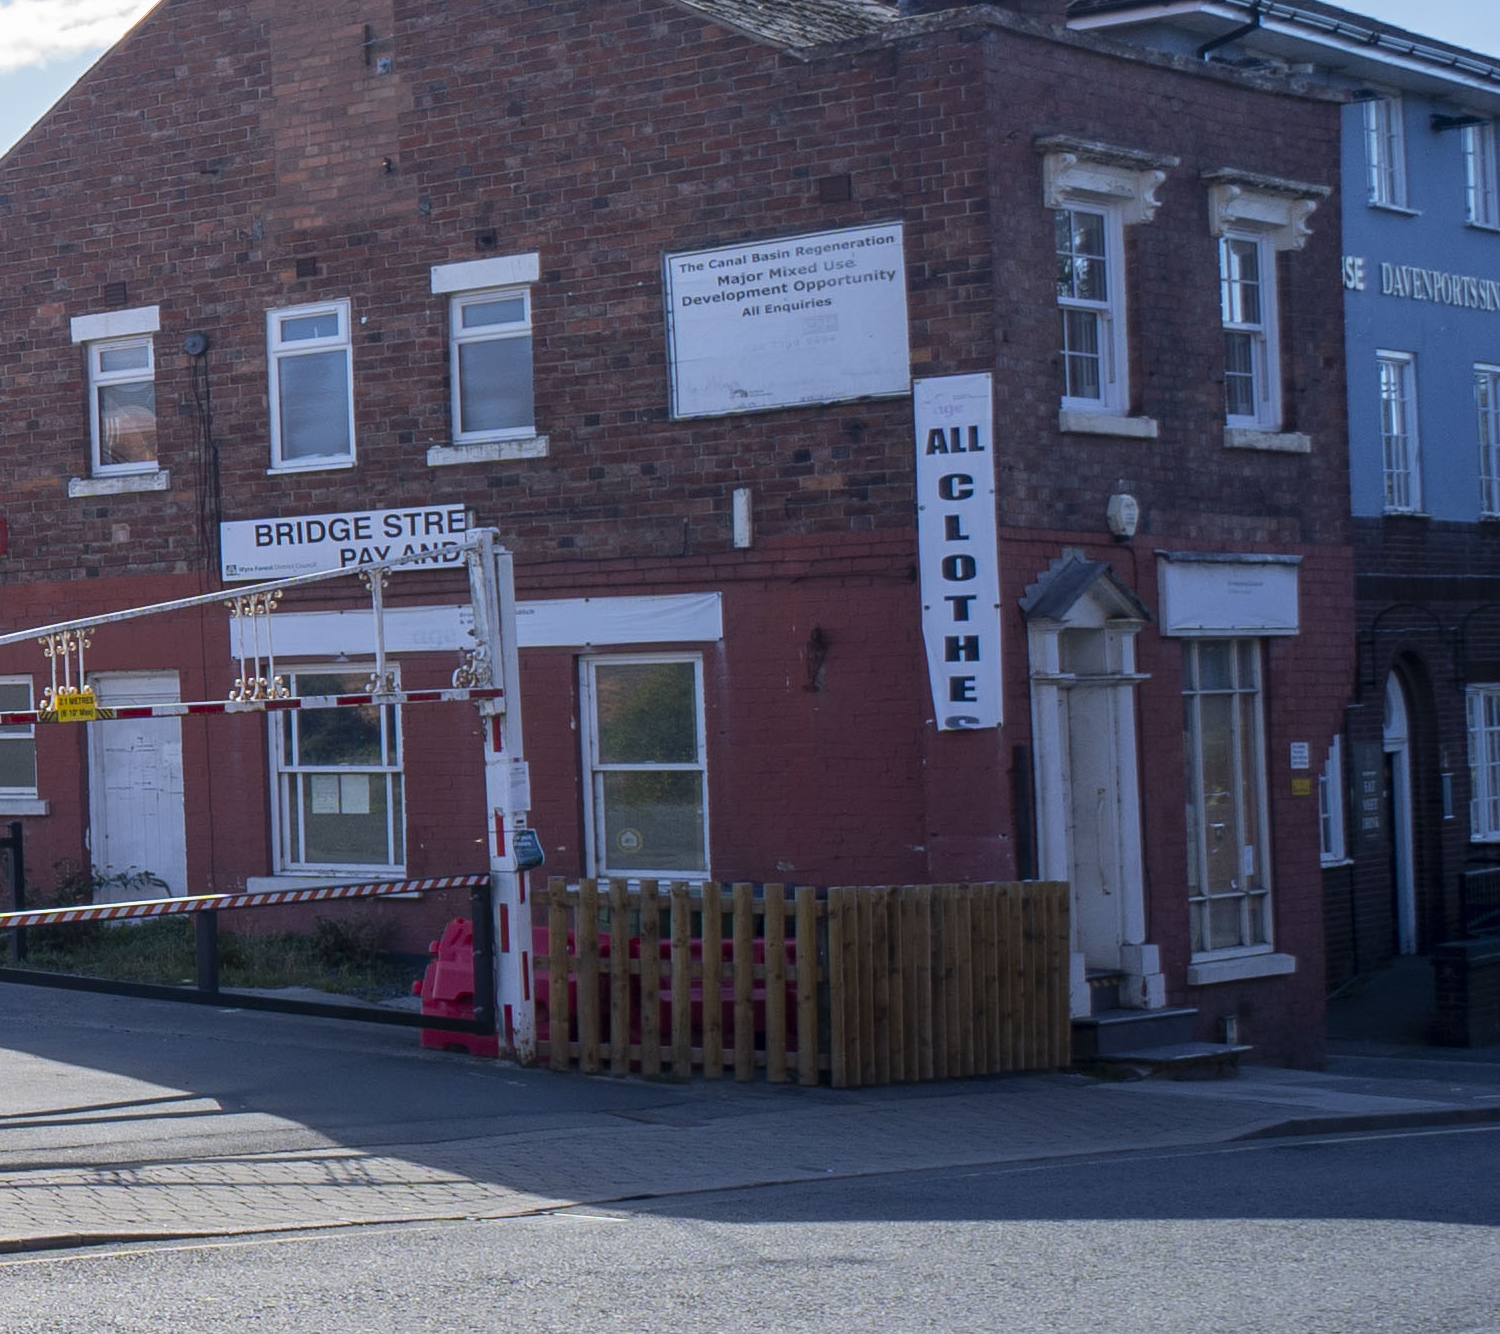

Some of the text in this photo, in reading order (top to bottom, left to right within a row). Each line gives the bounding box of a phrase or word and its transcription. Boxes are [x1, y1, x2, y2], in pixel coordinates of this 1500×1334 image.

[679, 234, 895, 274] The Canal Basin Regeneration
[681, 268, 897, 307] Development Opportunity
[717, 258, 857, 287] Major Mixed Use
[1381, 262, 1477, 308] DAVENPORTS
[742, 297, 832, 317] All Enquiries
[926, 425, 986, 455] ALL
[255, 509, 467, 547] BRIDGE STRE
[340, 541, 461, 568] PAY AND
